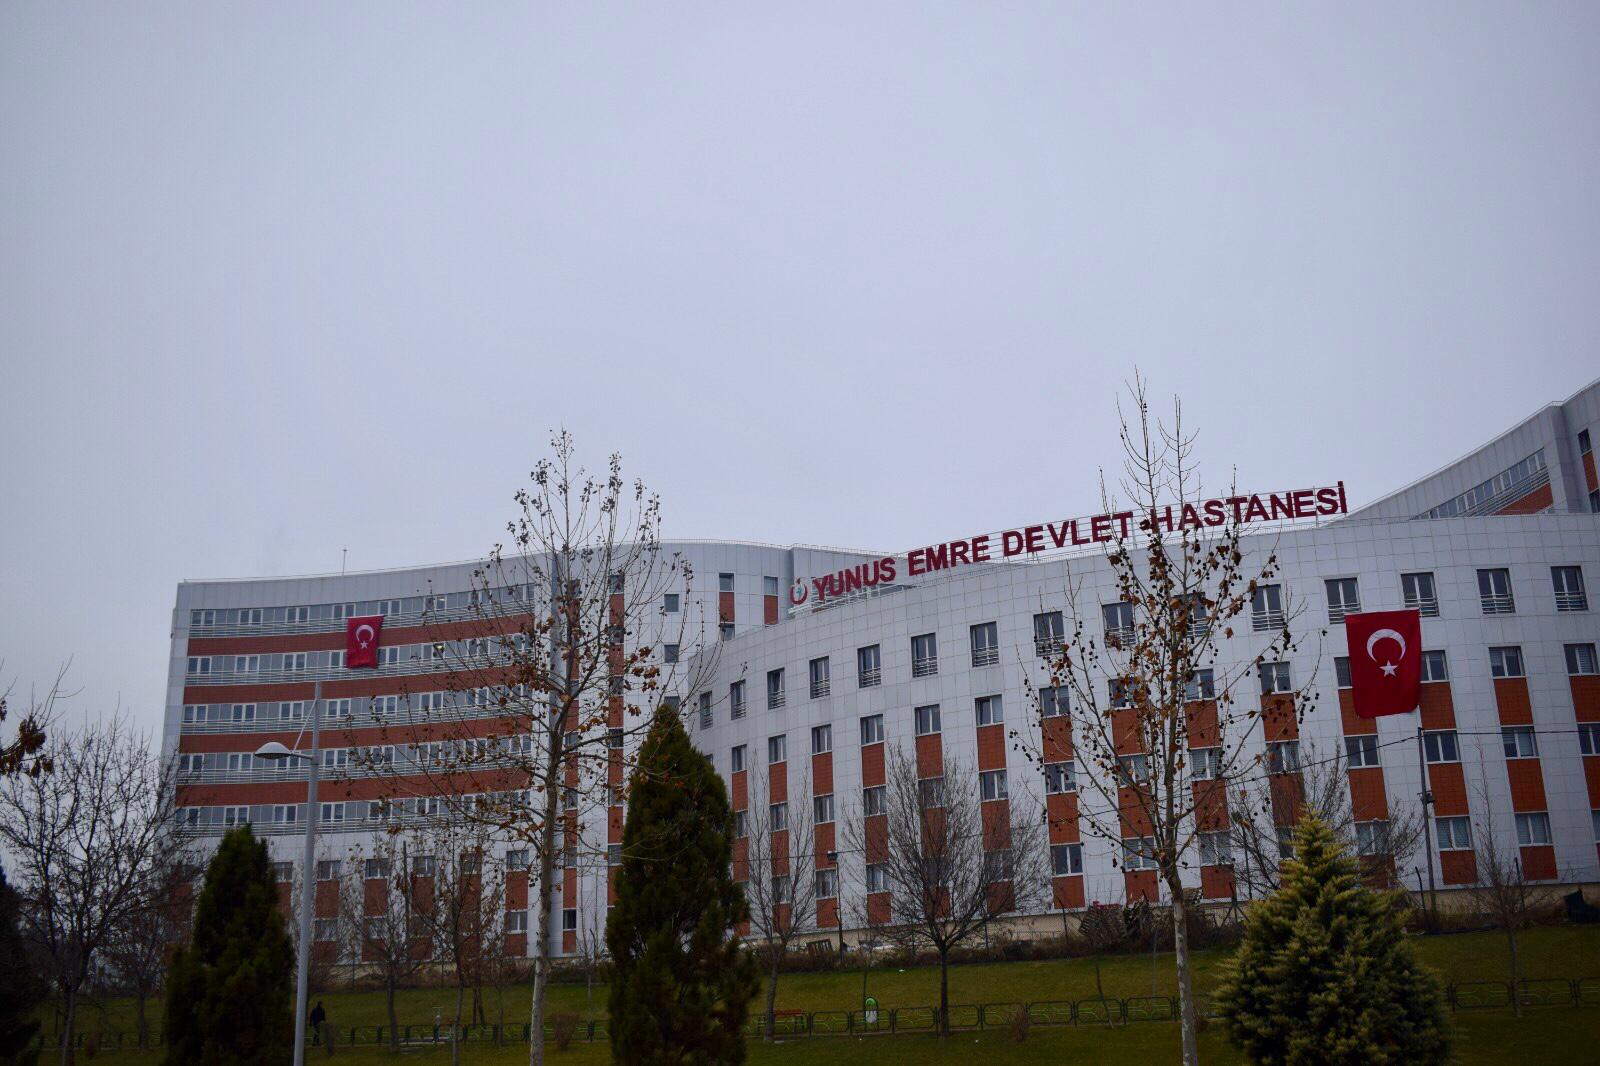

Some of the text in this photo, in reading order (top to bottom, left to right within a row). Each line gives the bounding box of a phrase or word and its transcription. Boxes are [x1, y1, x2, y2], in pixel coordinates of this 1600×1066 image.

[813, 480, 1348, 600] YUNUS EMRE DEVLET HASTANESİ
